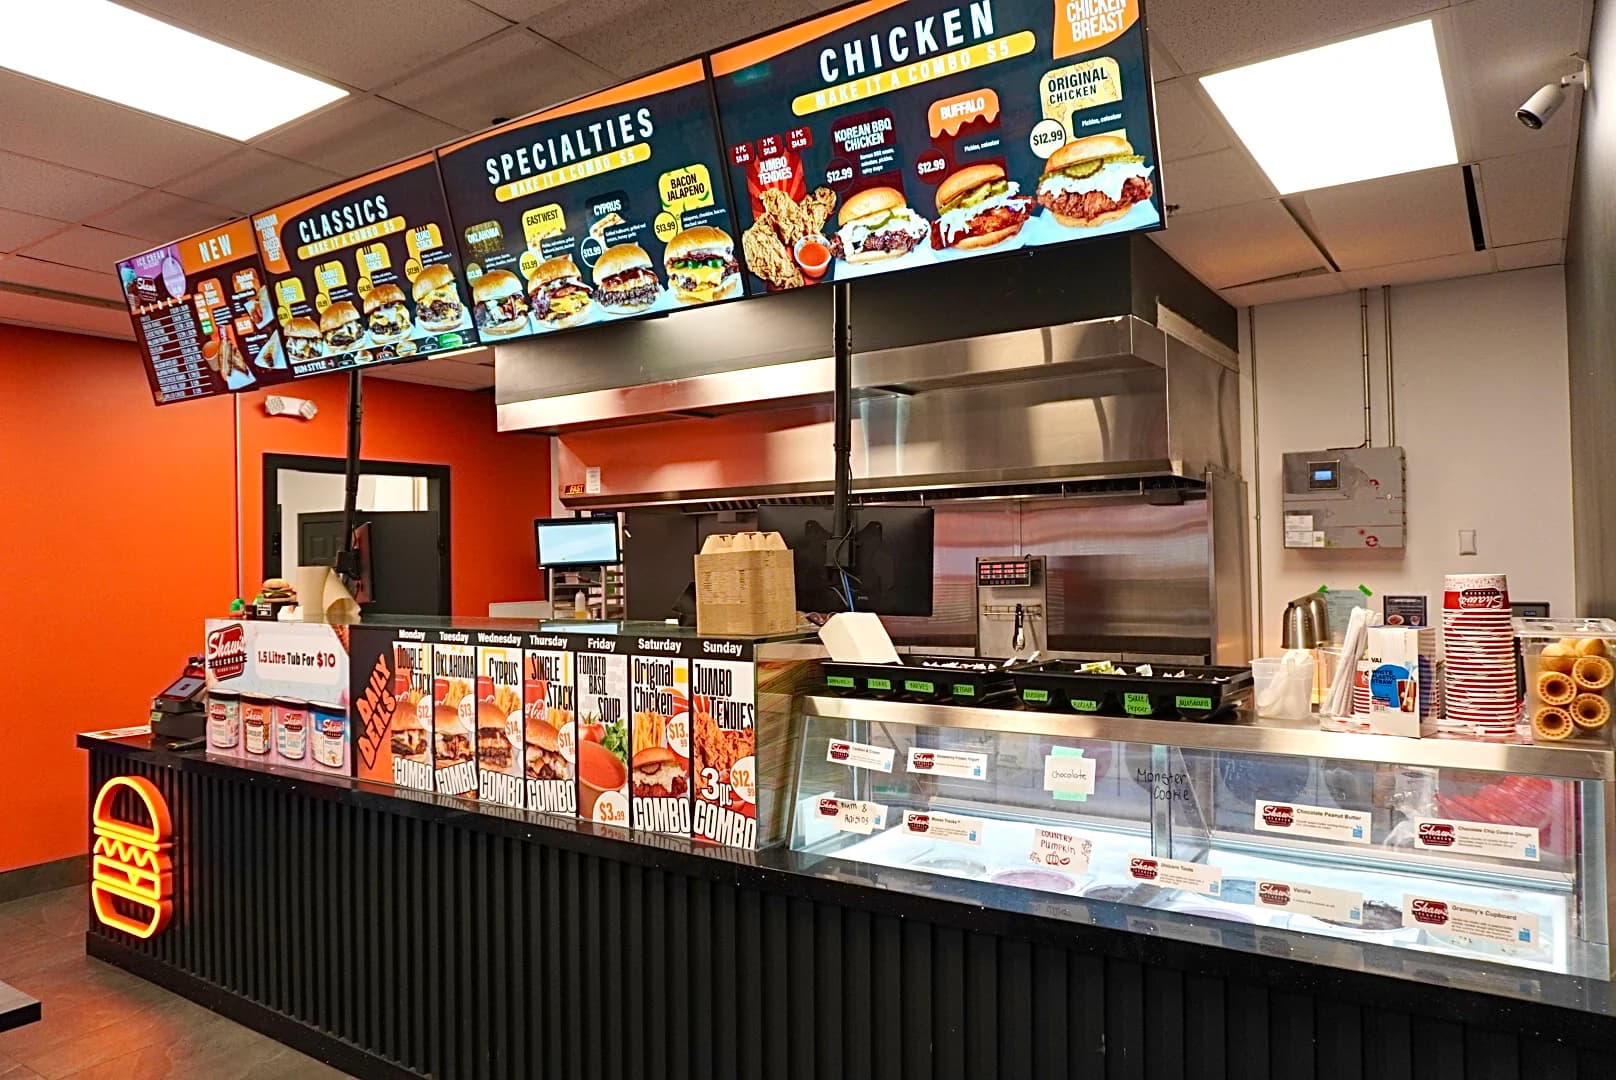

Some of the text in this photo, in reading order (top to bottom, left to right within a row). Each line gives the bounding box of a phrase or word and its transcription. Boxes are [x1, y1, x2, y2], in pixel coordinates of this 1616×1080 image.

[1072, 9, 1125, 43] BREAST
[820, 1, 995, 83] CHICKEN
[815, 42, 1009, 107] MAKE IT A COMBO $5
[1048, 67, 1108, 92] ORIGINAL
[1050, 85, 1098, 105] CHICKEN
[940, 98, 985, 120] BUFFALO
[834, 118, 892, 143] KOREAN BBQ
[1033, 130, 1063, 147] $12.99
[486, 108, 654, 185] SPECIALTIES
[845, 132, 885, 152] CHICKEN
[759, 156, 787, 173] JUMBO
[917, 158, 946, 175] $12.99
[510, 179, 539, 197] MAKE
[543, 173, 555, 188] IT
[559, 169, 567, 181] A
[570, 155, 611, 180] COMBO
[670, 173, 697, 190] BACON
[758, 167, 793, 185] TENDIES
[827, 167, 853, 184] $12.99
[667, 182, 705, 202] JALAPENO
[593, 200, 621, 216] CYPRUS
[299, 195, 388, 243] CLASSICS
[655, 221, 676, 234] $13.99
[198, 234, 232, 263] NEW
[521, 261, 538, 272] $13.99
[308, 360, 327, 372] STYLE
[208, 632, 246, 659] Shaw's
[399, 630, 425, 641] Monday
[439, 632, 469, 644] Tuesday
[478, 633, 521, 646] Wednesday
[529, 635, 568, 649] Thursday
[588, 639, 616, 652] Friday
[638, 639, 681, 653] Saturday
[703, 641, 742, 656] Sunday
[258, 651, 337, 668] 1.5 Litre Tub For $10
[397, 645, 423, 671] DOUBLE
[435, 651, 474, 679] OKLAHOMA
[531, 652, 560, 682] SINGLE
[579, 655, 607, 675] TOMATO
[489, 657, 518, 686] CYPRUS
[634, 658, 674, 690] Original
[694, 664, 732, 697] JUMBO
[356, 653, 391, 726] DAILY
[409, 670, 431, 696] STACK
[588, 675, 608, 695] BASIL
[547, 682, 574, 712] STACK
[634, 686, 673, 716] Chicken
[598, 697, 620, 723] SOUP
[710, 697, 754, 730] TENDIES
[357, 689, 396, 770] DEALS
[394, 757, 434, 791] COMBO
[435, 760, 478, 795] COMBO
[1137, 767, 1186, 785] Monster
[479, 769, 523, 808] COMBO
[527, 780, 576, 813] COMBO
[1154, 786, 1189, 801] Cookie
[600, 802, 625, 821] $3.99
[633, 798, 691, 833] COMBO
[861, 804, 868, 813] &
[1296, 808, 1362, 822] Chocolate Peanut Butter
[694, 800, 757, 850] COMBO
[1041, 830, 1073, 843] COUNTRY
[1293, 887, 1312, 895] Vanilla
[1451, 904, 1517, 921] Grammy's Cupboard
